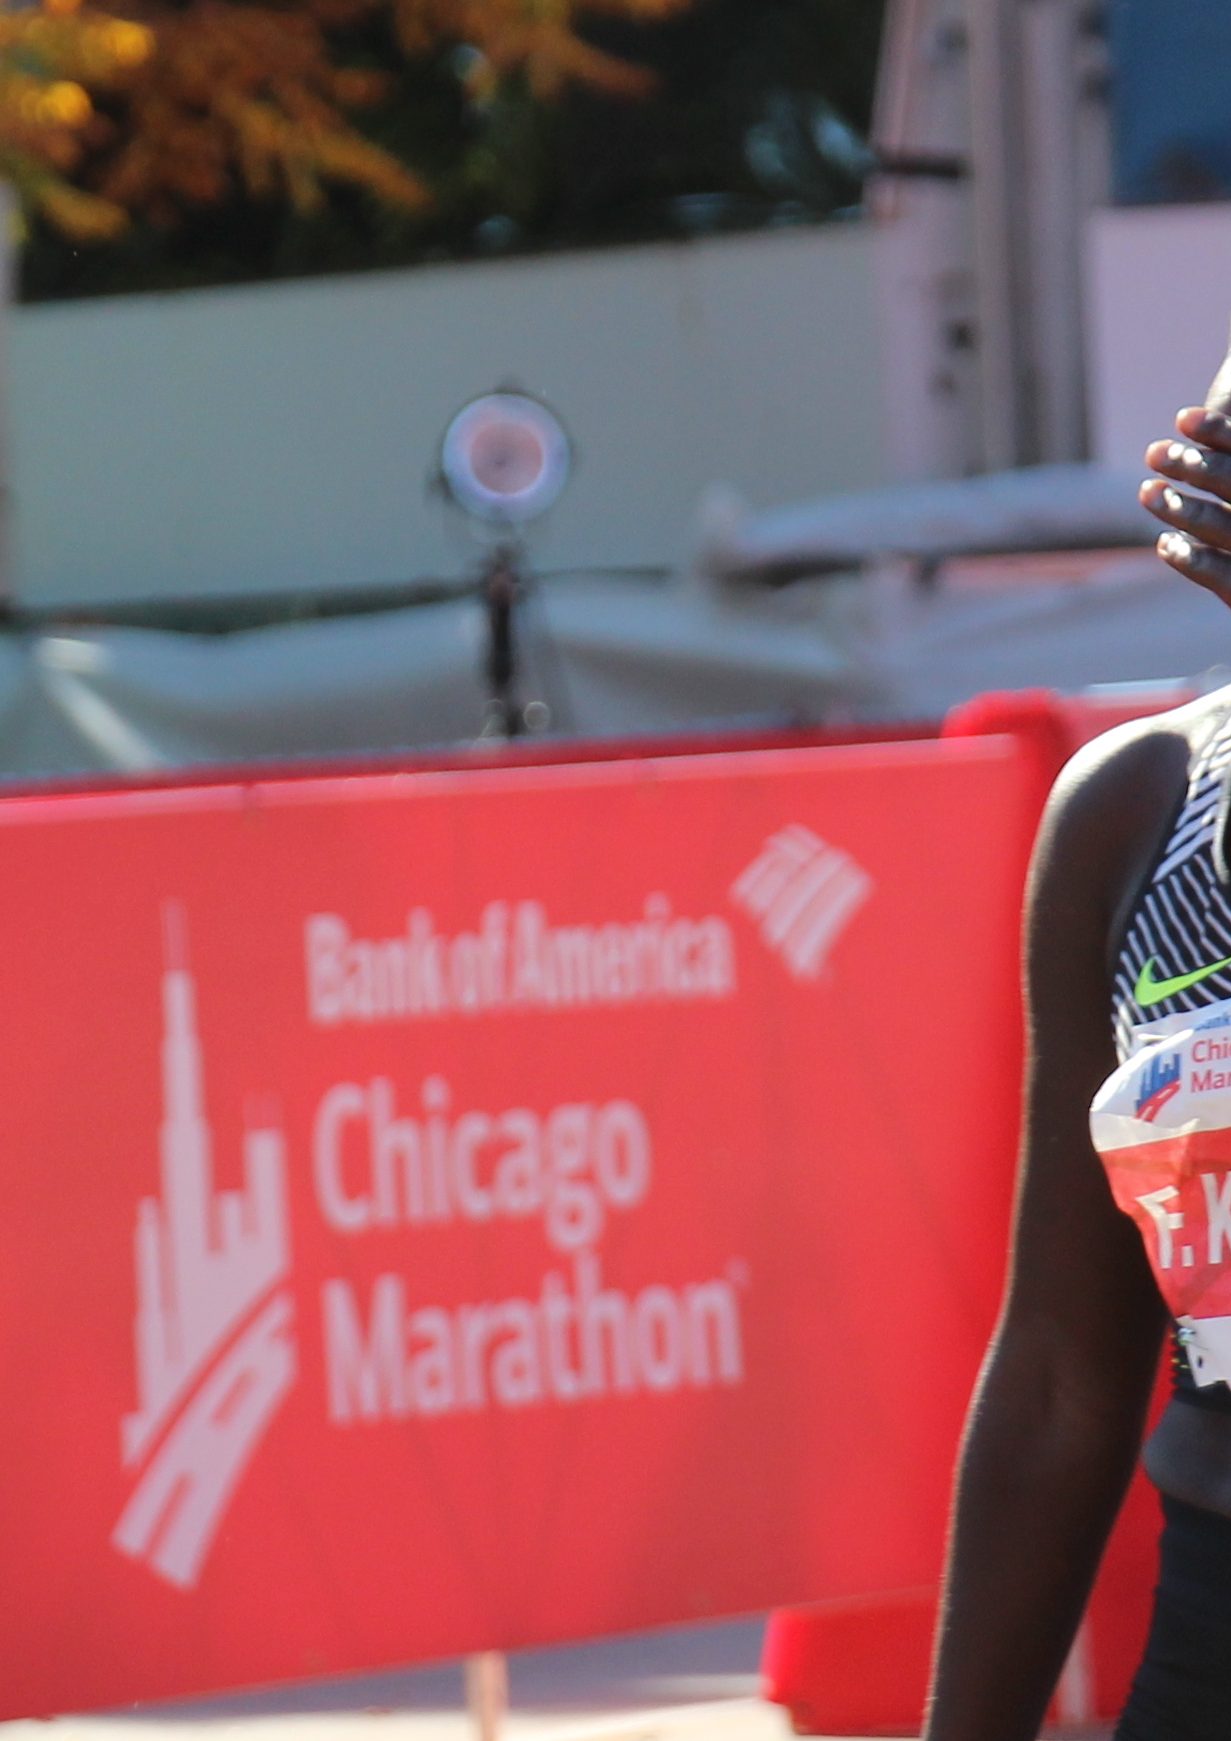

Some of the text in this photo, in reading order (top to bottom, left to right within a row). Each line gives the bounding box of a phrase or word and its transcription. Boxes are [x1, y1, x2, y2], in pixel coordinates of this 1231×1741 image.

[305, 892, 736, 1025] Bank of America
[1195, 1011, 1230, 1031] ank
[313, 1075, 650, 1250] Chicago
[1136, 1185, 1195, 1269] F.
[321, 1253, 744, 1424] Marathon
